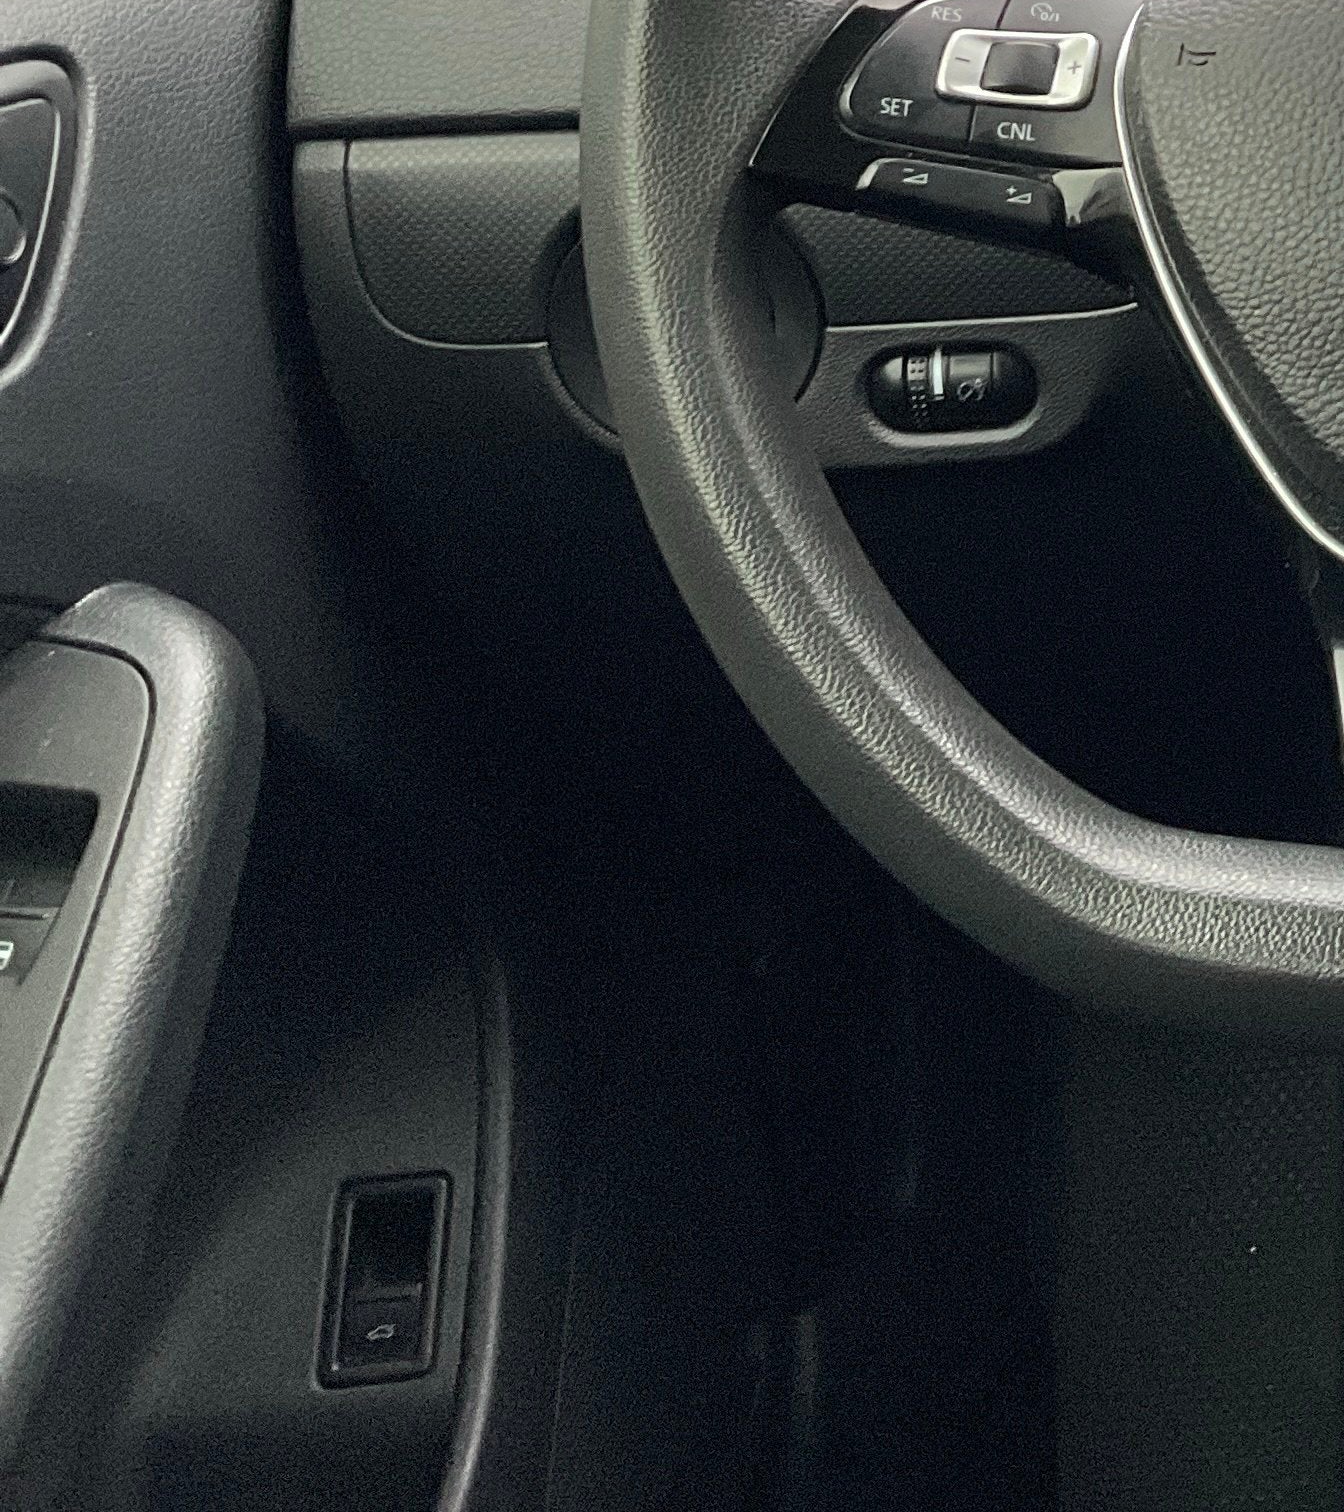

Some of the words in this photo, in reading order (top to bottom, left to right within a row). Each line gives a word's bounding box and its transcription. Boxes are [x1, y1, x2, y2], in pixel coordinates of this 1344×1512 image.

[931, 6, 962, 23] RES
[880, 97, 913, 118] SET
[996, 121, 1036, 142] CNL
